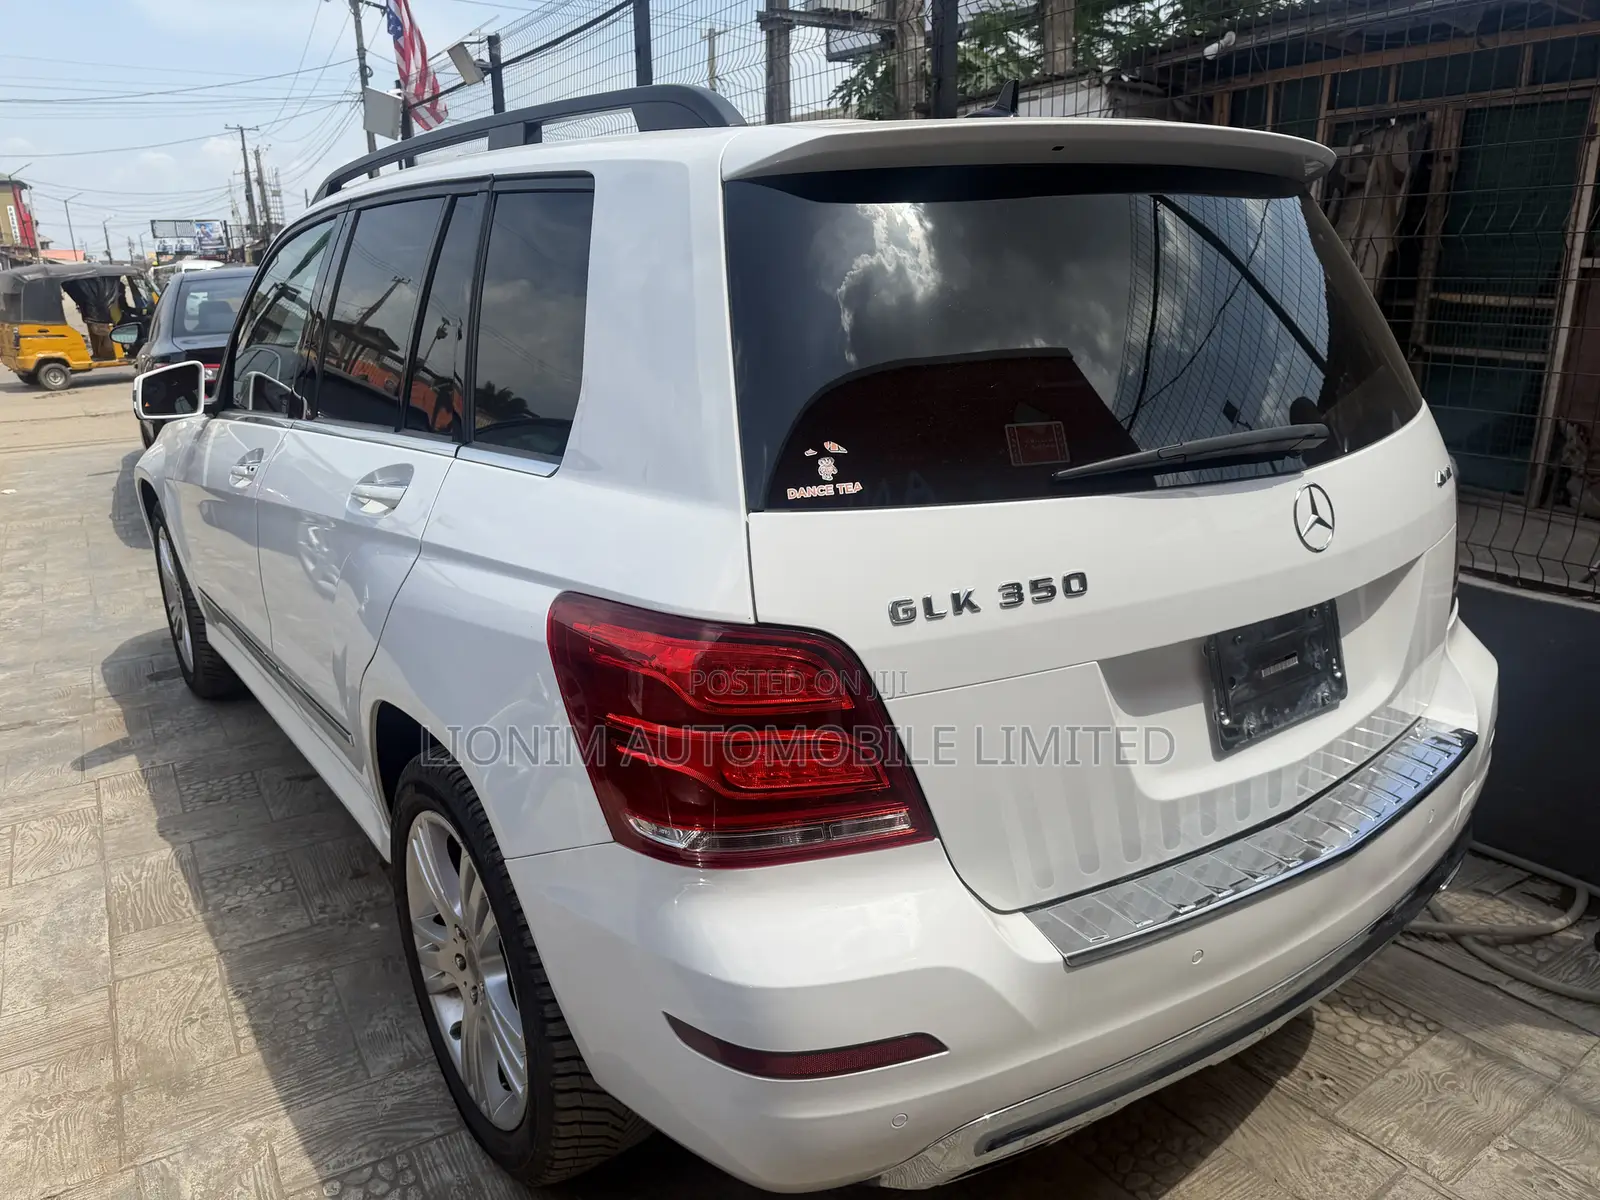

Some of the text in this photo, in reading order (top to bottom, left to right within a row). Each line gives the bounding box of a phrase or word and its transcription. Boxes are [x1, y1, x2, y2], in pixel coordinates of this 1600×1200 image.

[787, 481, 863, 500] DANCE TEA
[888, 569, 1088, 627] GLK 350
